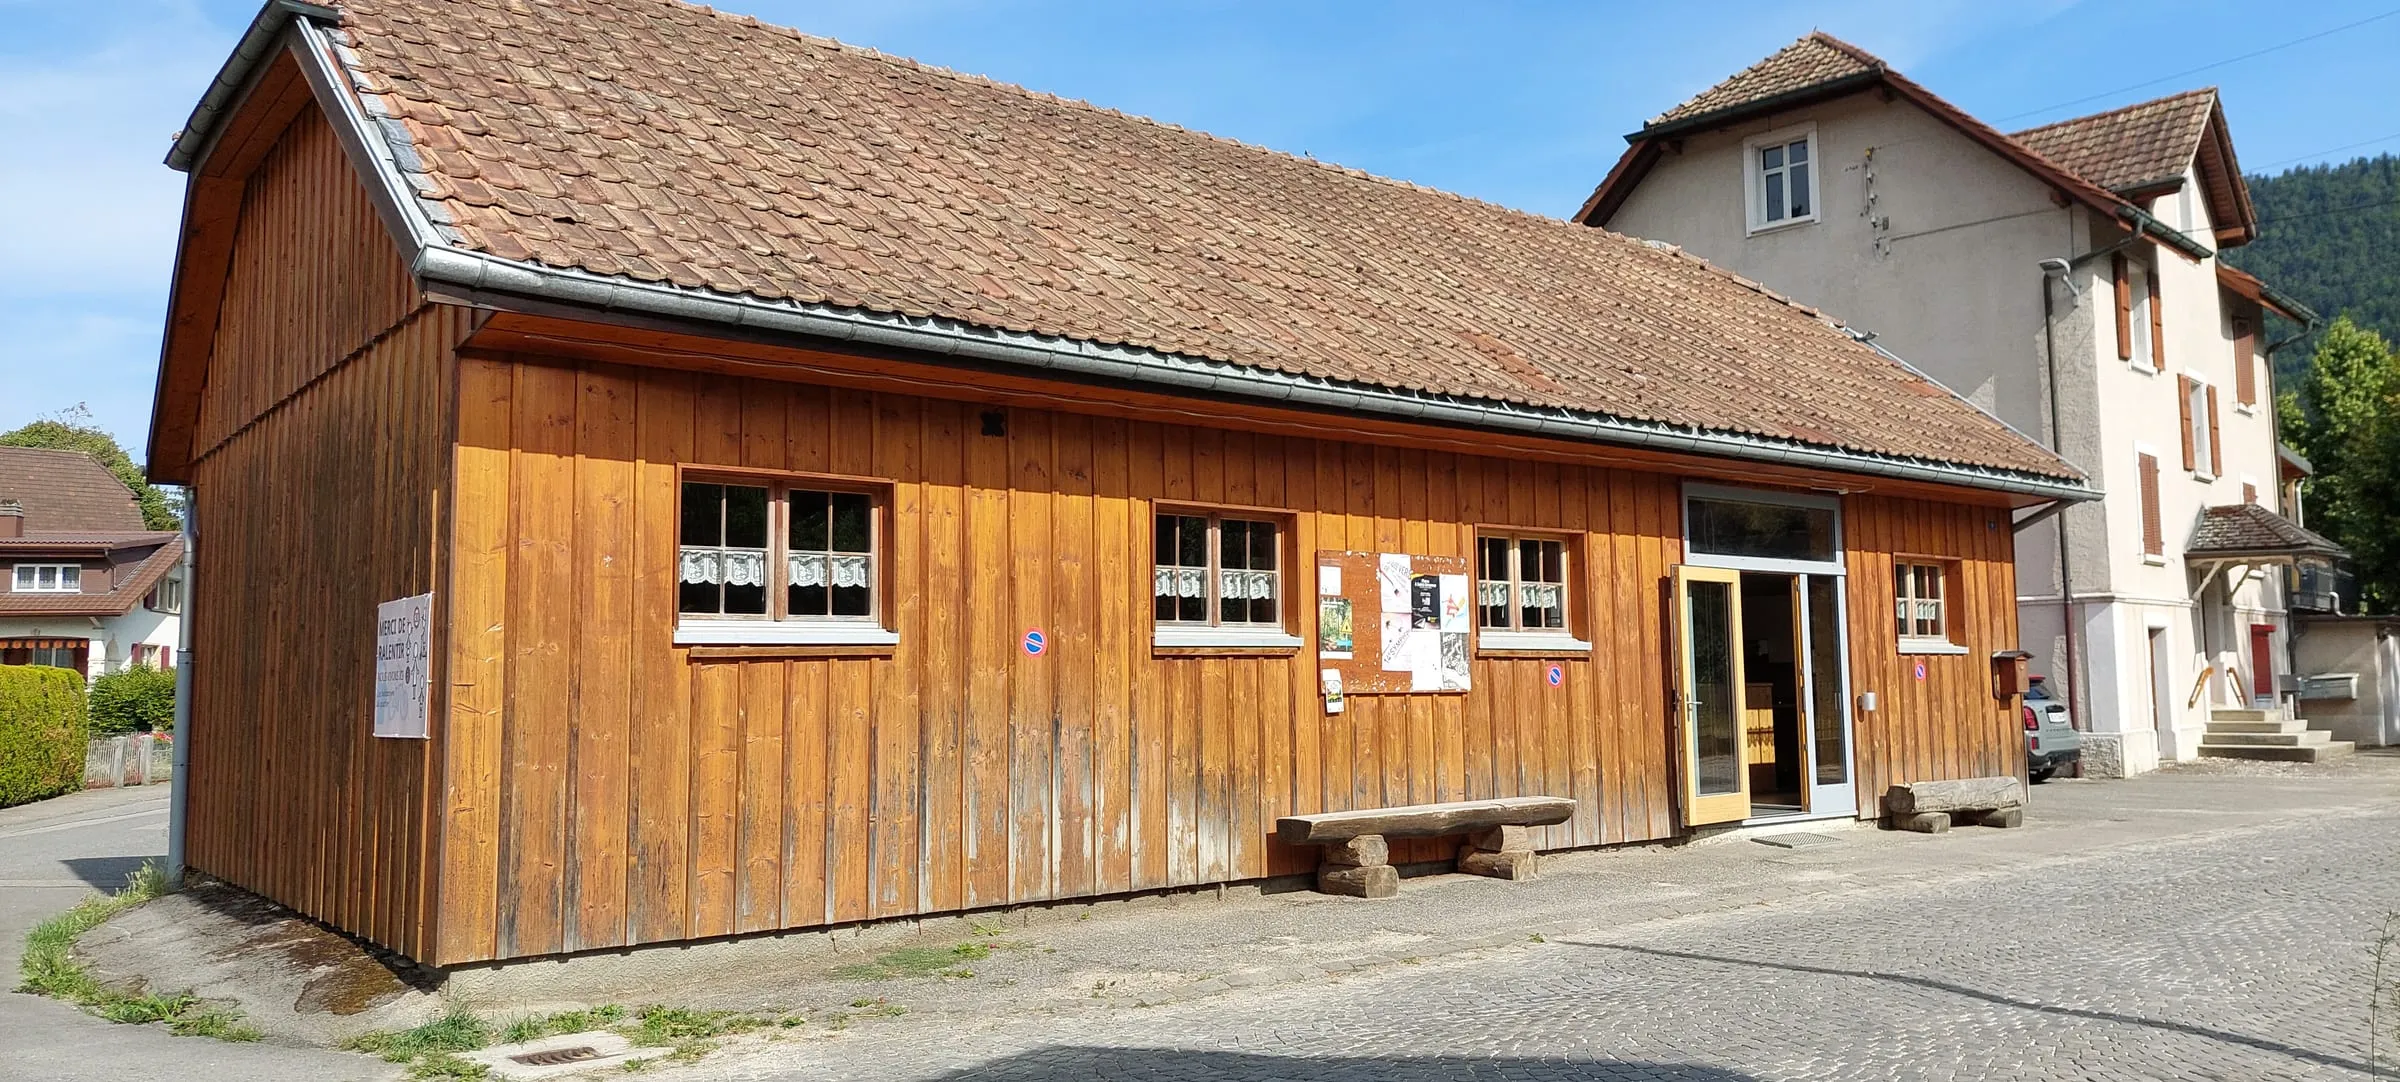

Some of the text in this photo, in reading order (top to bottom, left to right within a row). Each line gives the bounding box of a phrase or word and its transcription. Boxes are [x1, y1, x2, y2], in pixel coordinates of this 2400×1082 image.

[380, 619, 396, 636] MERCI
[398, 617, 405, 634] DE
[379, 643, 404, 660] RALENTIR
